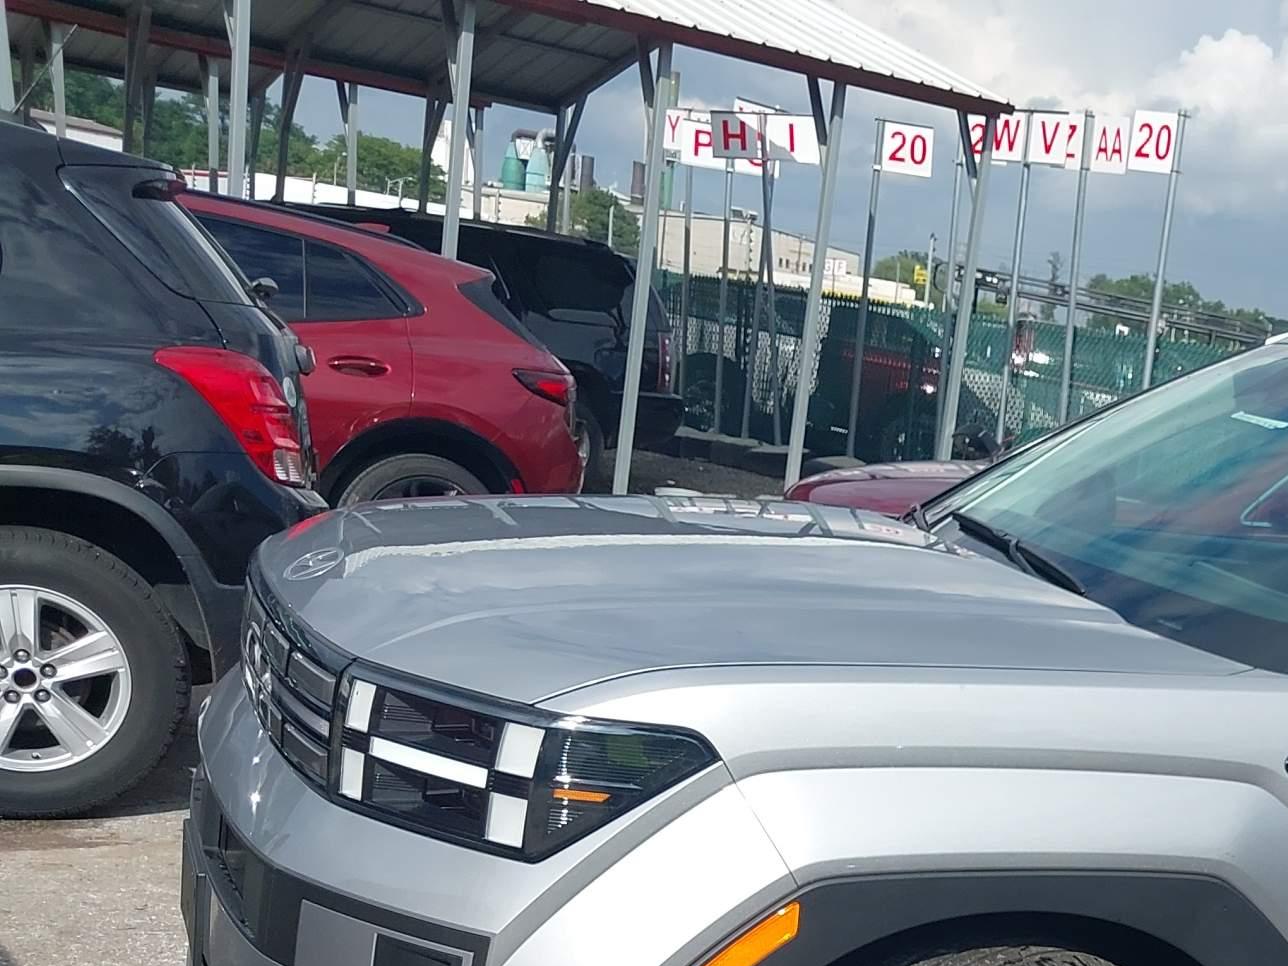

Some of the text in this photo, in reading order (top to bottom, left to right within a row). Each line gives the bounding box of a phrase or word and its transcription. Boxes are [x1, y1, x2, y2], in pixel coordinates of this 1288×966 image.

[668, 115, 680, 143] Y
[721, 120, 747, 151] H
[788, 123, 795, 153] I
[992, 118, 1021, 152] W
[1041, 120, 1060, 154] V
[1096, 126, 1123, 162] AA
[1134, 122, 1172, 161] 20
[888, 131, 927, 166] 20
